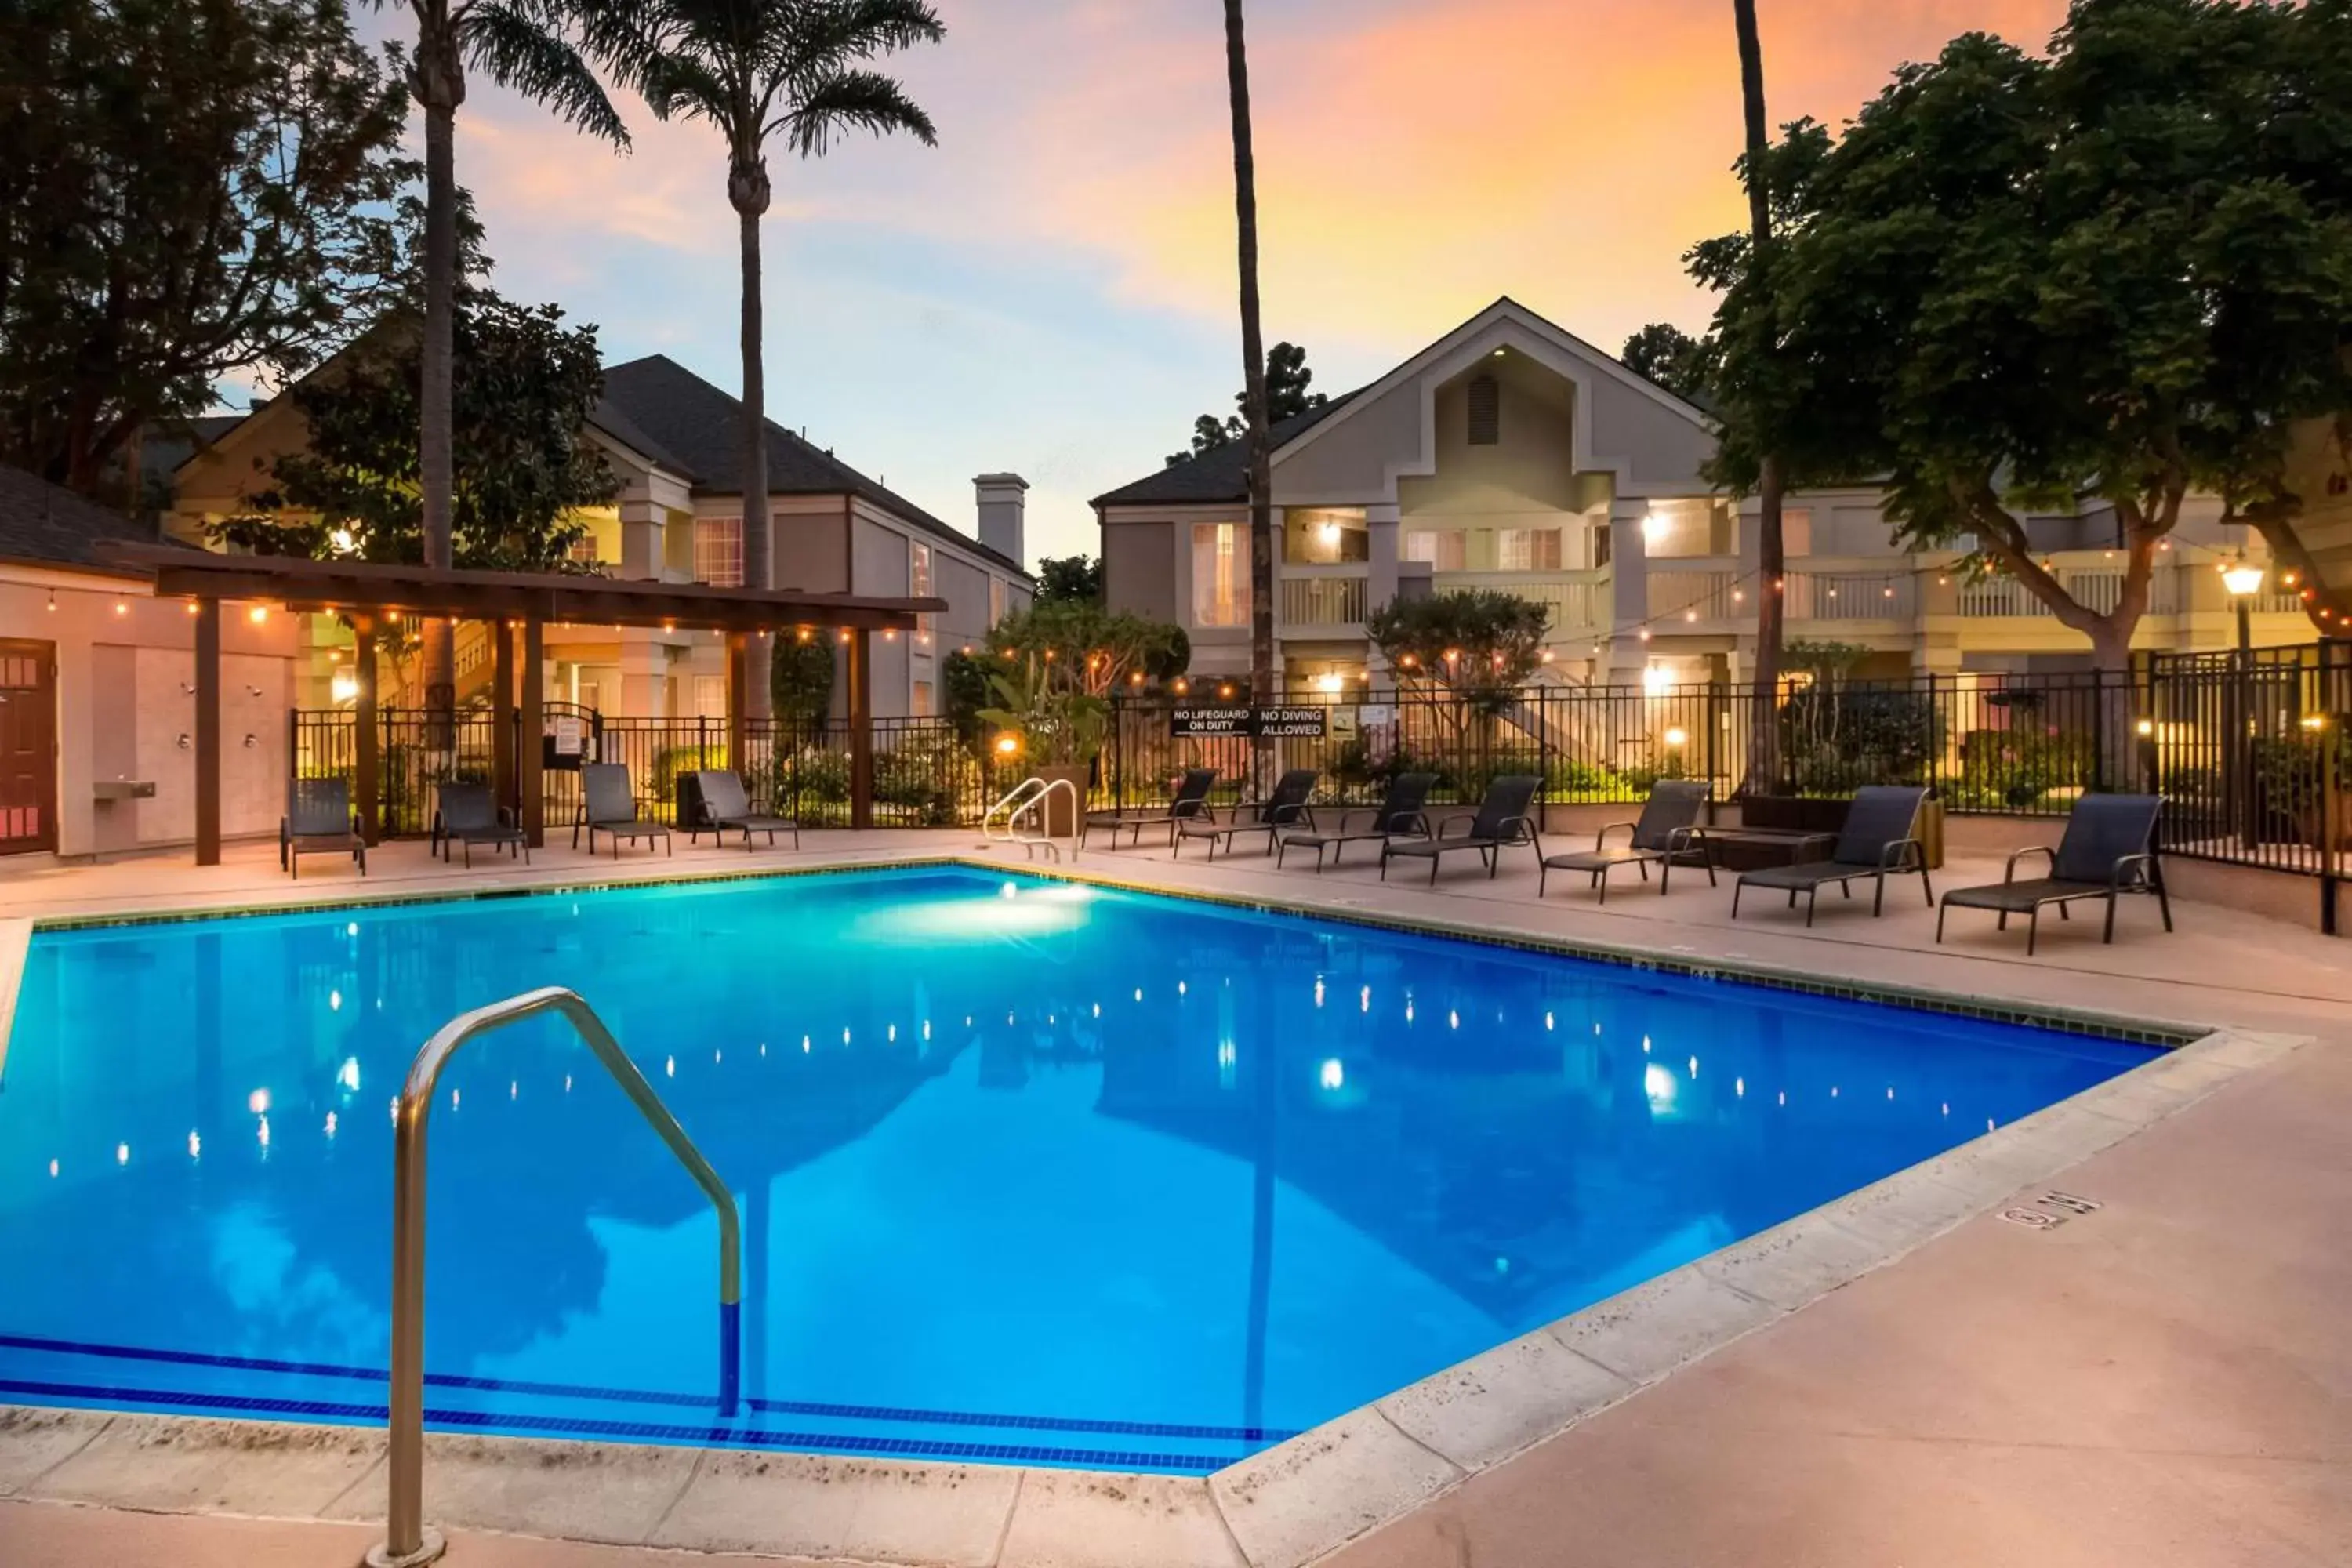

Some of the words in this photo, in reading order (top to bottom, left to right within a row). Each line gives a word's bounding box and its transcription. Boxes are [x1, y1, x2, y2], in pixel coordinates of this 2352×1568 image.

[1174, 709, 1189, 720] NO
[1191, 709, 1249, 719] LIFEGUARD
[1261, 710, 1279, 720] NO
[1282, 710, 1322, 720] DIVING
[1189, 720, 1205, 730] ON
[1207, 720, 1234, 730] DUTY
[1261, 724, 1321, 735] ALLOWED
